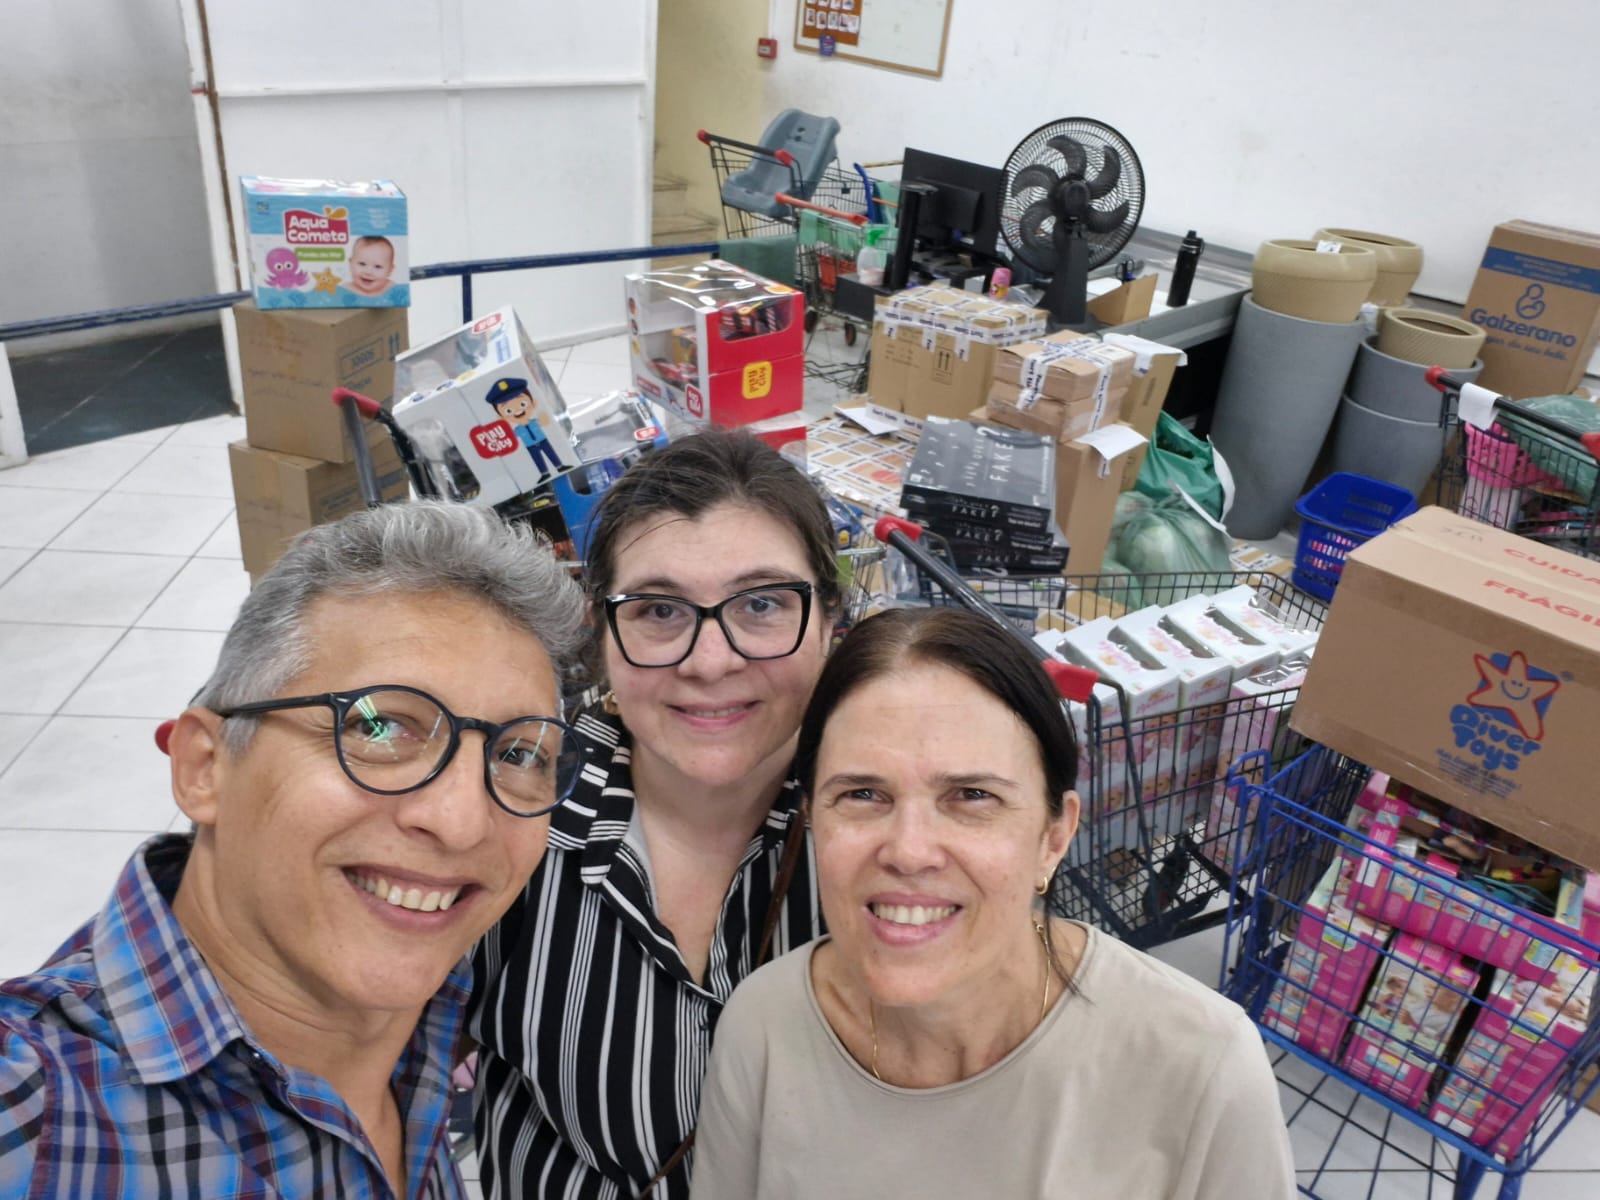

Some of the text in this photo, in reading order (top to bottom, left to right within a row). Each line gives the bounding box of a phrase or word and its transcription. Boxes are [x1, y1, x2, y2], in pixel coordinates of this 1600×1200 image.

[288, 229, 347, 242] Cometa
[289, 215, 329, 231] Aqua
[1470, 308, 1577, 347] Galzerano
[1450, 703, 1542, 756] Diver
[1452, 725, 1521, 771] Toys
